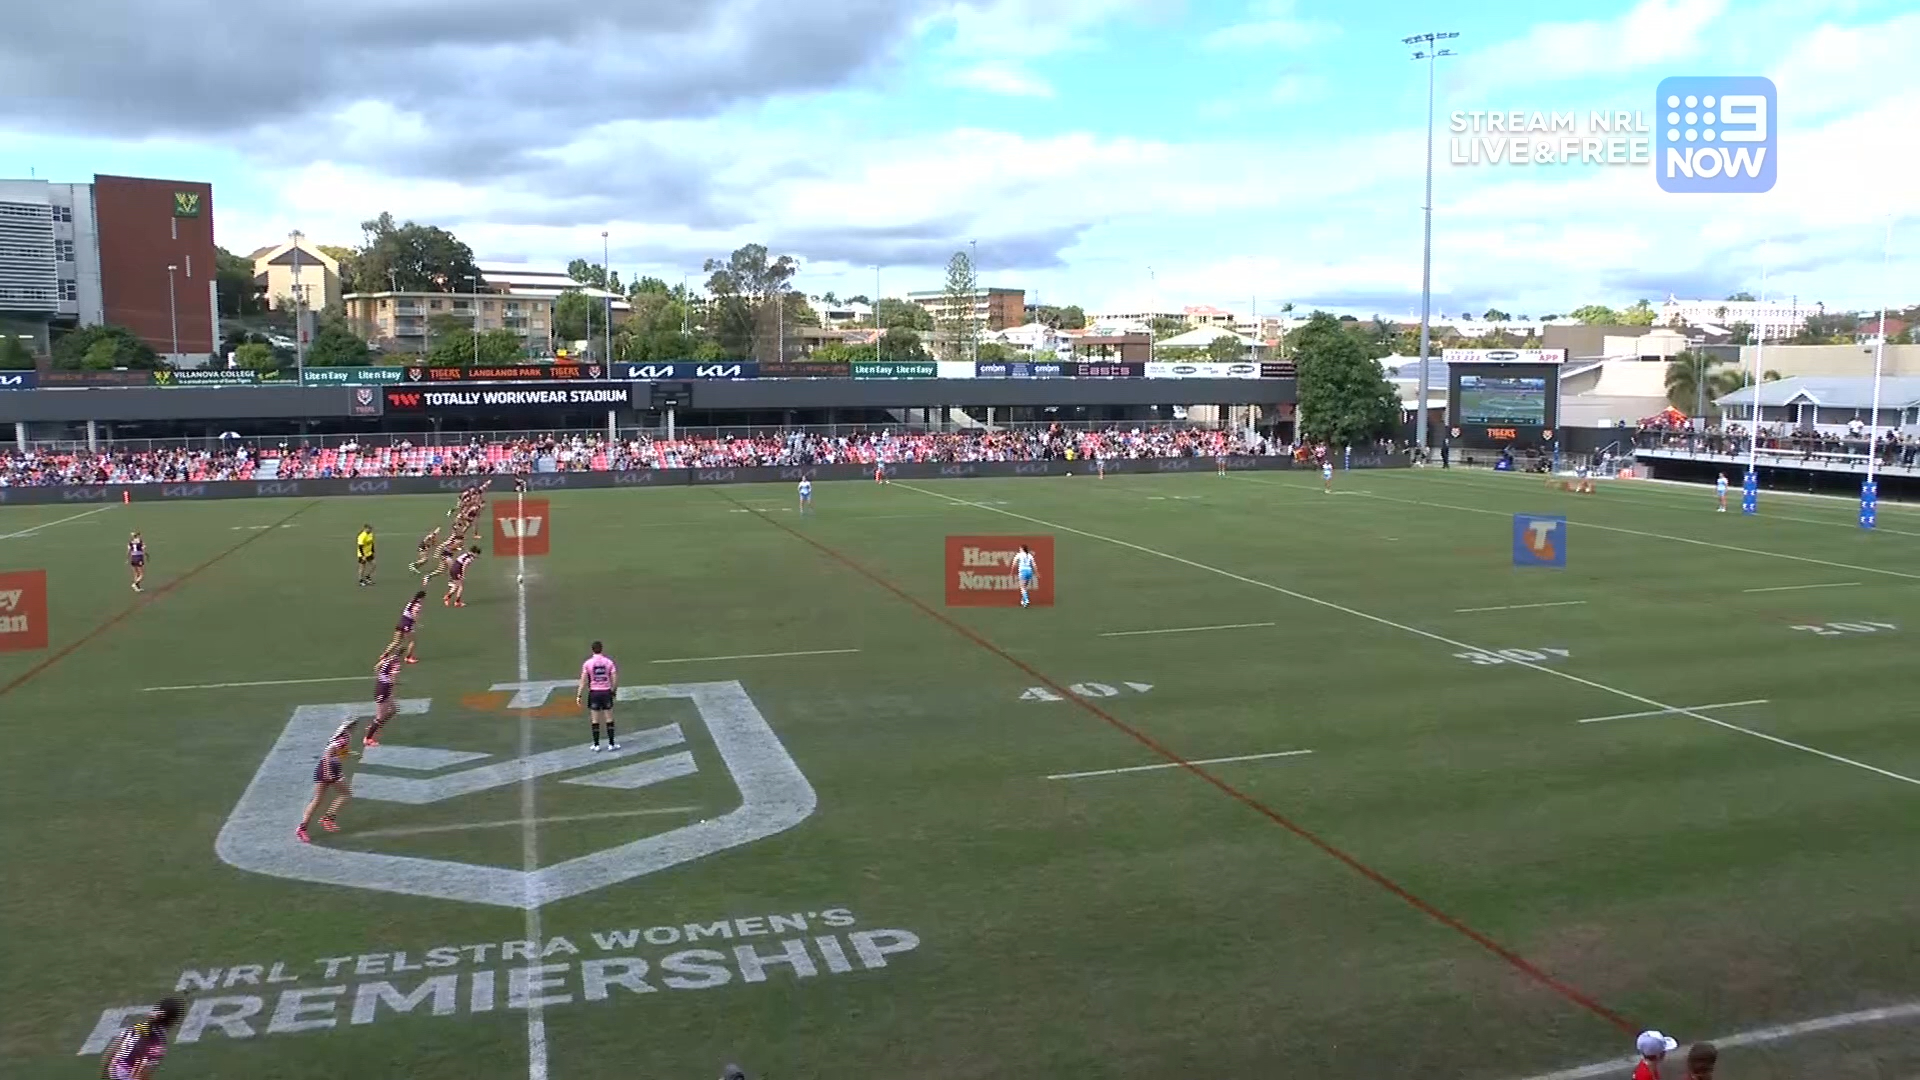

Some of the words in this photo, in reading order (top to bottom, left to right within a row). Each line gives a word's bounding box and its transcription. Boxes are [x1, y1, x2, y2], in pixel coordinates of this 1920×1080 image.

[173, 370, 219, 378] VILLANOVA
[220, 369, 255, 378] COLLEGE
[429, 369, 460, 379] TIGERS
[468, 369, 518, 377] LANGLANDS
[519, 368, 542, 376] PARK
[550, 367, 580, 377] TIGERS
[1078, 364, 1130, 376] Easts
[328, 371, 348, 381] Easy
[381, 371, 401, 381] Easy
[424, 392, 481, 406] TOTALLY
[482, 391, 568, 404] WORKWEAR
[570, 390, 627, 402] STADIUM
[1486, 429, 1516, 438] TIGERS
[1452, 649, 1547, 665] 30
[1019, 682, 1119, 701] 40
[175, 961, 297, 992] NRL
[315, 935, 579, 979] TELSTRA
[591, 908, 855, 950] WOMEN'S
